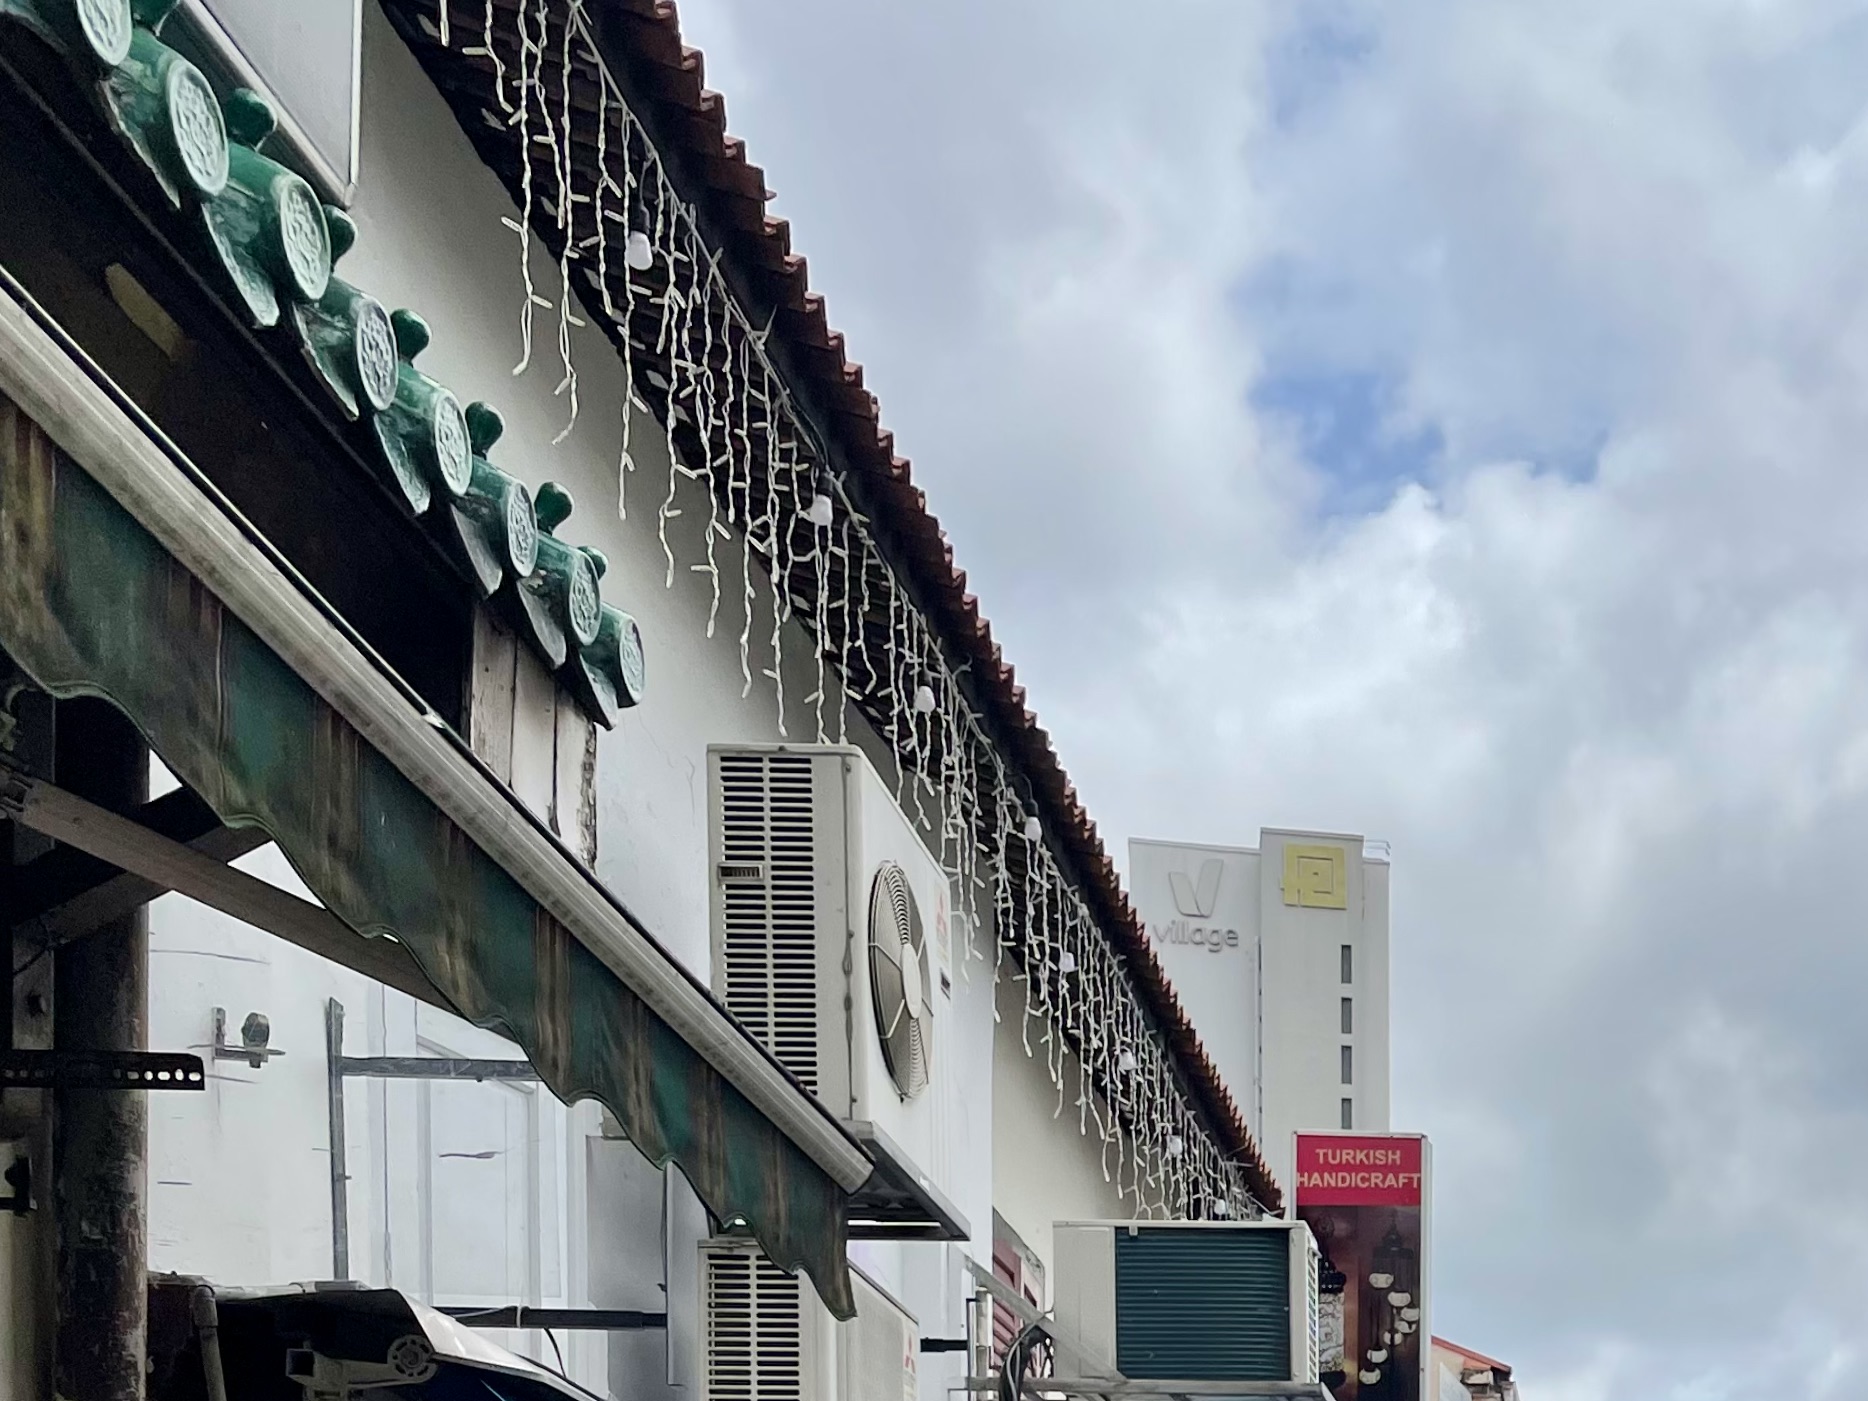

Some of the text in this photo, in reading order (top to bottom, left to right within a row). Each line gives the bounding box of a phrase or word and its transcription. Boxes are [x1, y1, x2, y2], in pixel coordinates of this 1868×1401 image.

[1153, 919, 1239, 953] village
[1315, 1148, 1401, 1166] TURKISH
[1297, 1171, 1421, 1189] HANDICRAFT
